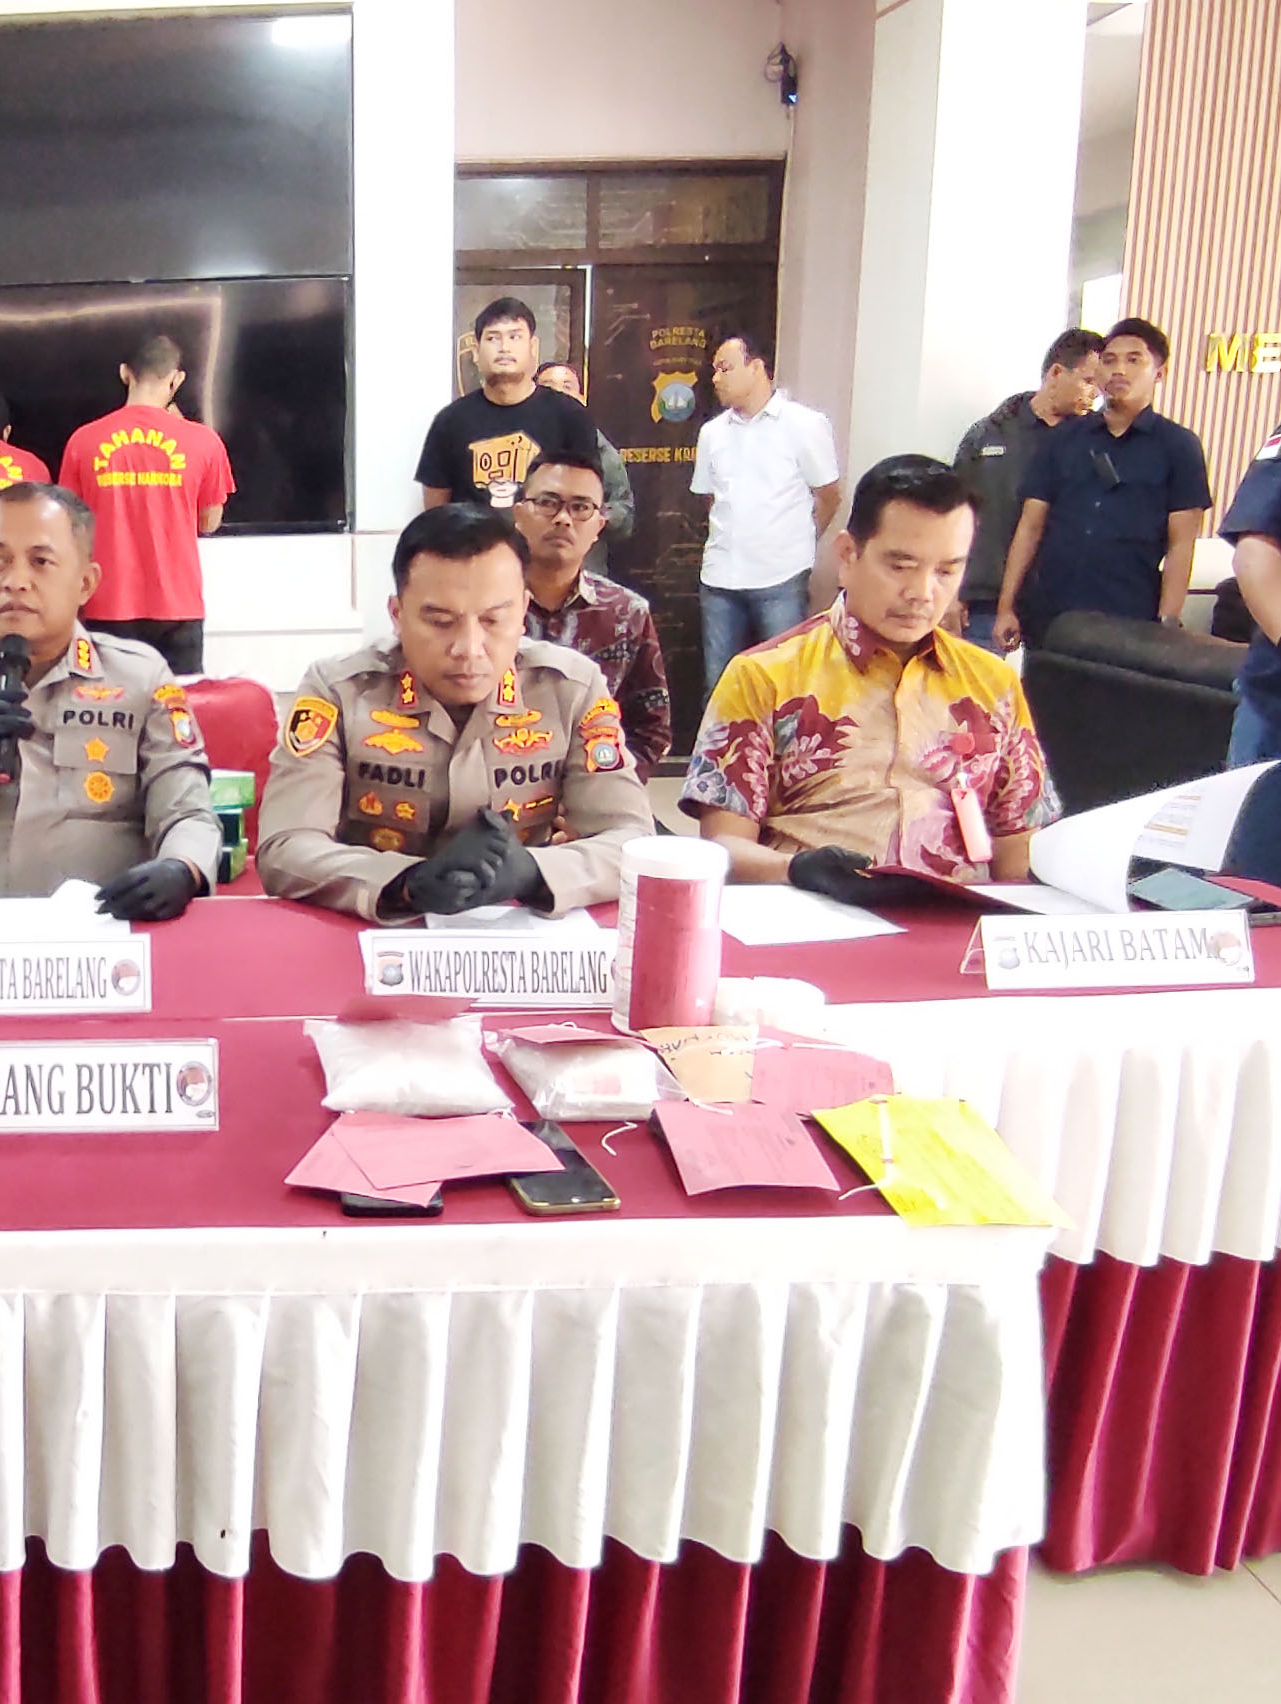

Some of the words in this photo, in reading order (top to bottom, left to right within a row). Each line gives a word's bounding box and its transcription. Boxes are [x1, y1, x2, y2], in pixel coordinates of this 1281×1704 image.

[93, 427, 187, 472] TAHANAN
[62, 709, 135, 731] POLRI
[358, 761, 426, 788] FADLI
[494, 759, 566, 789] POLRI
[1023, 930, 1115, 970] KAJARI
[1119, 928, 1212, 961] BATAM
[22, 957, 107, 1000] BARELANG
[409, 951, 528, 993] WAKAPOLRESTA
[531, 951, 607, 993] BARELANG
[76, 1062, 173, 1115] BUKTI
